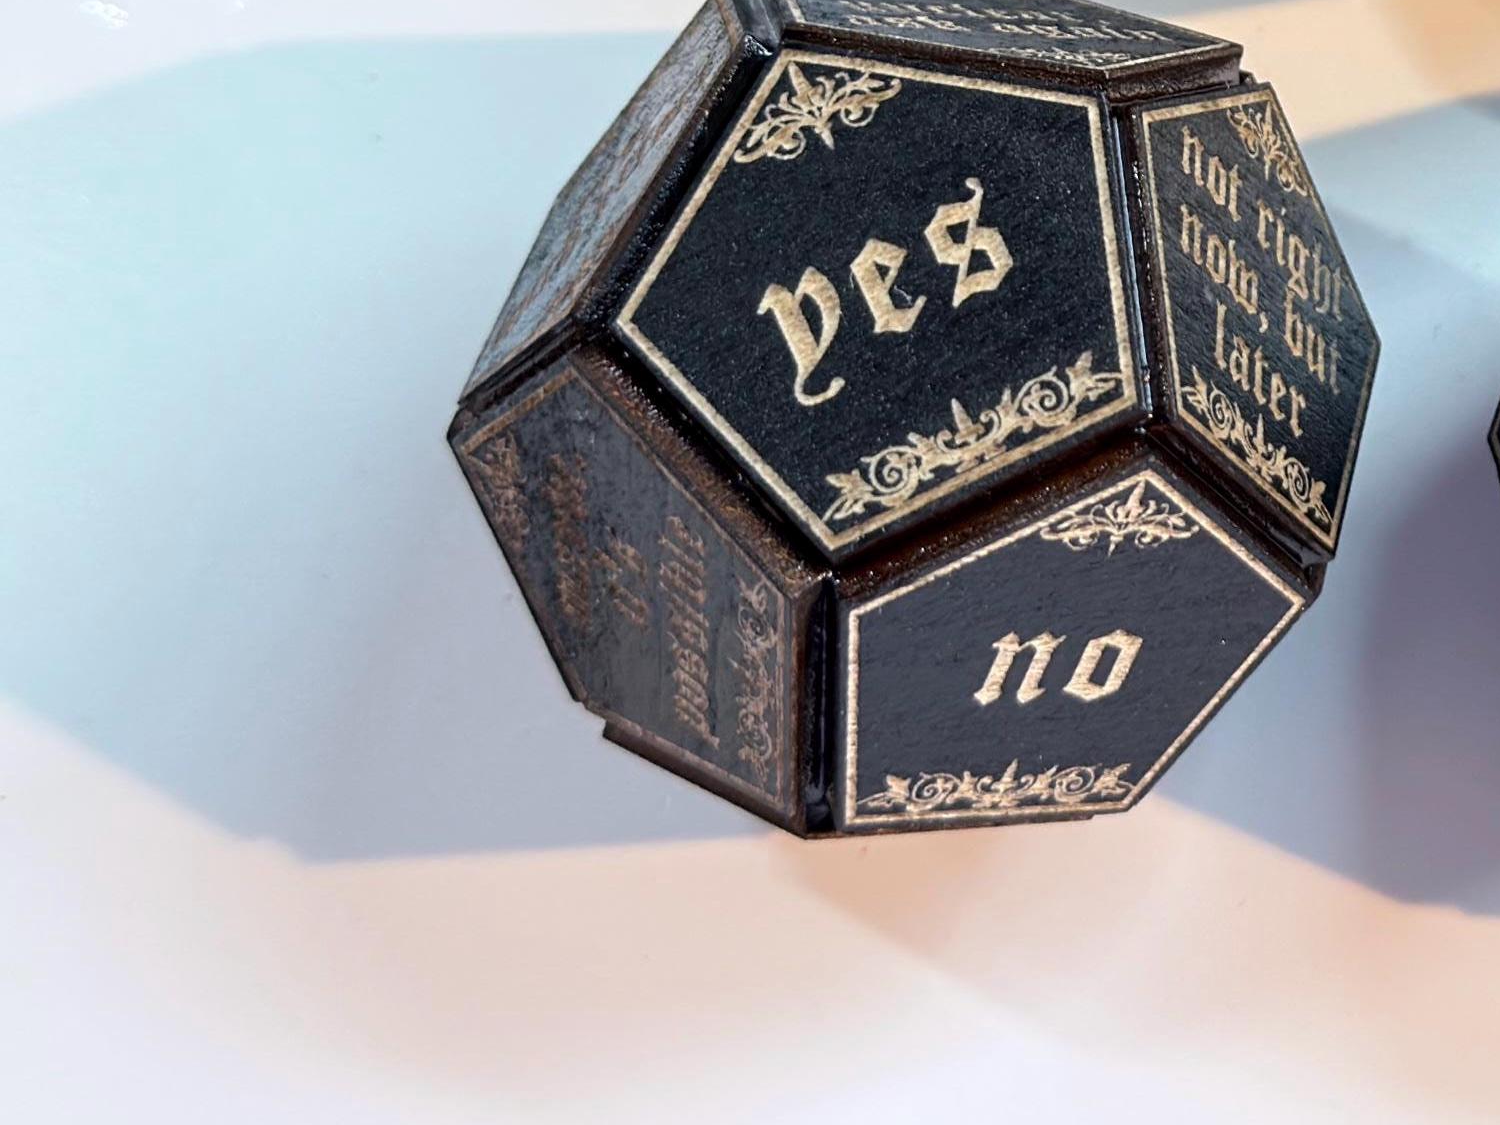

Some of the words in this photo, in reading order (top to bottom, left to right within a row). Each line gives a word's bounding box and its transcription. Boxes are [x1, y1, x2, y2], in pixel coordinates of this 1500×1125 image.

[757, 177, 1014, 406] yes
[1180, 203, 1270, 334] now,
[1283, 286, 1342, 395] but
[1181, 124, 1243, 223] not
[1257, 199, 1343, 321] right
[1213, 299, 1306, 438] later
[972, 628, 1144, 706] no
